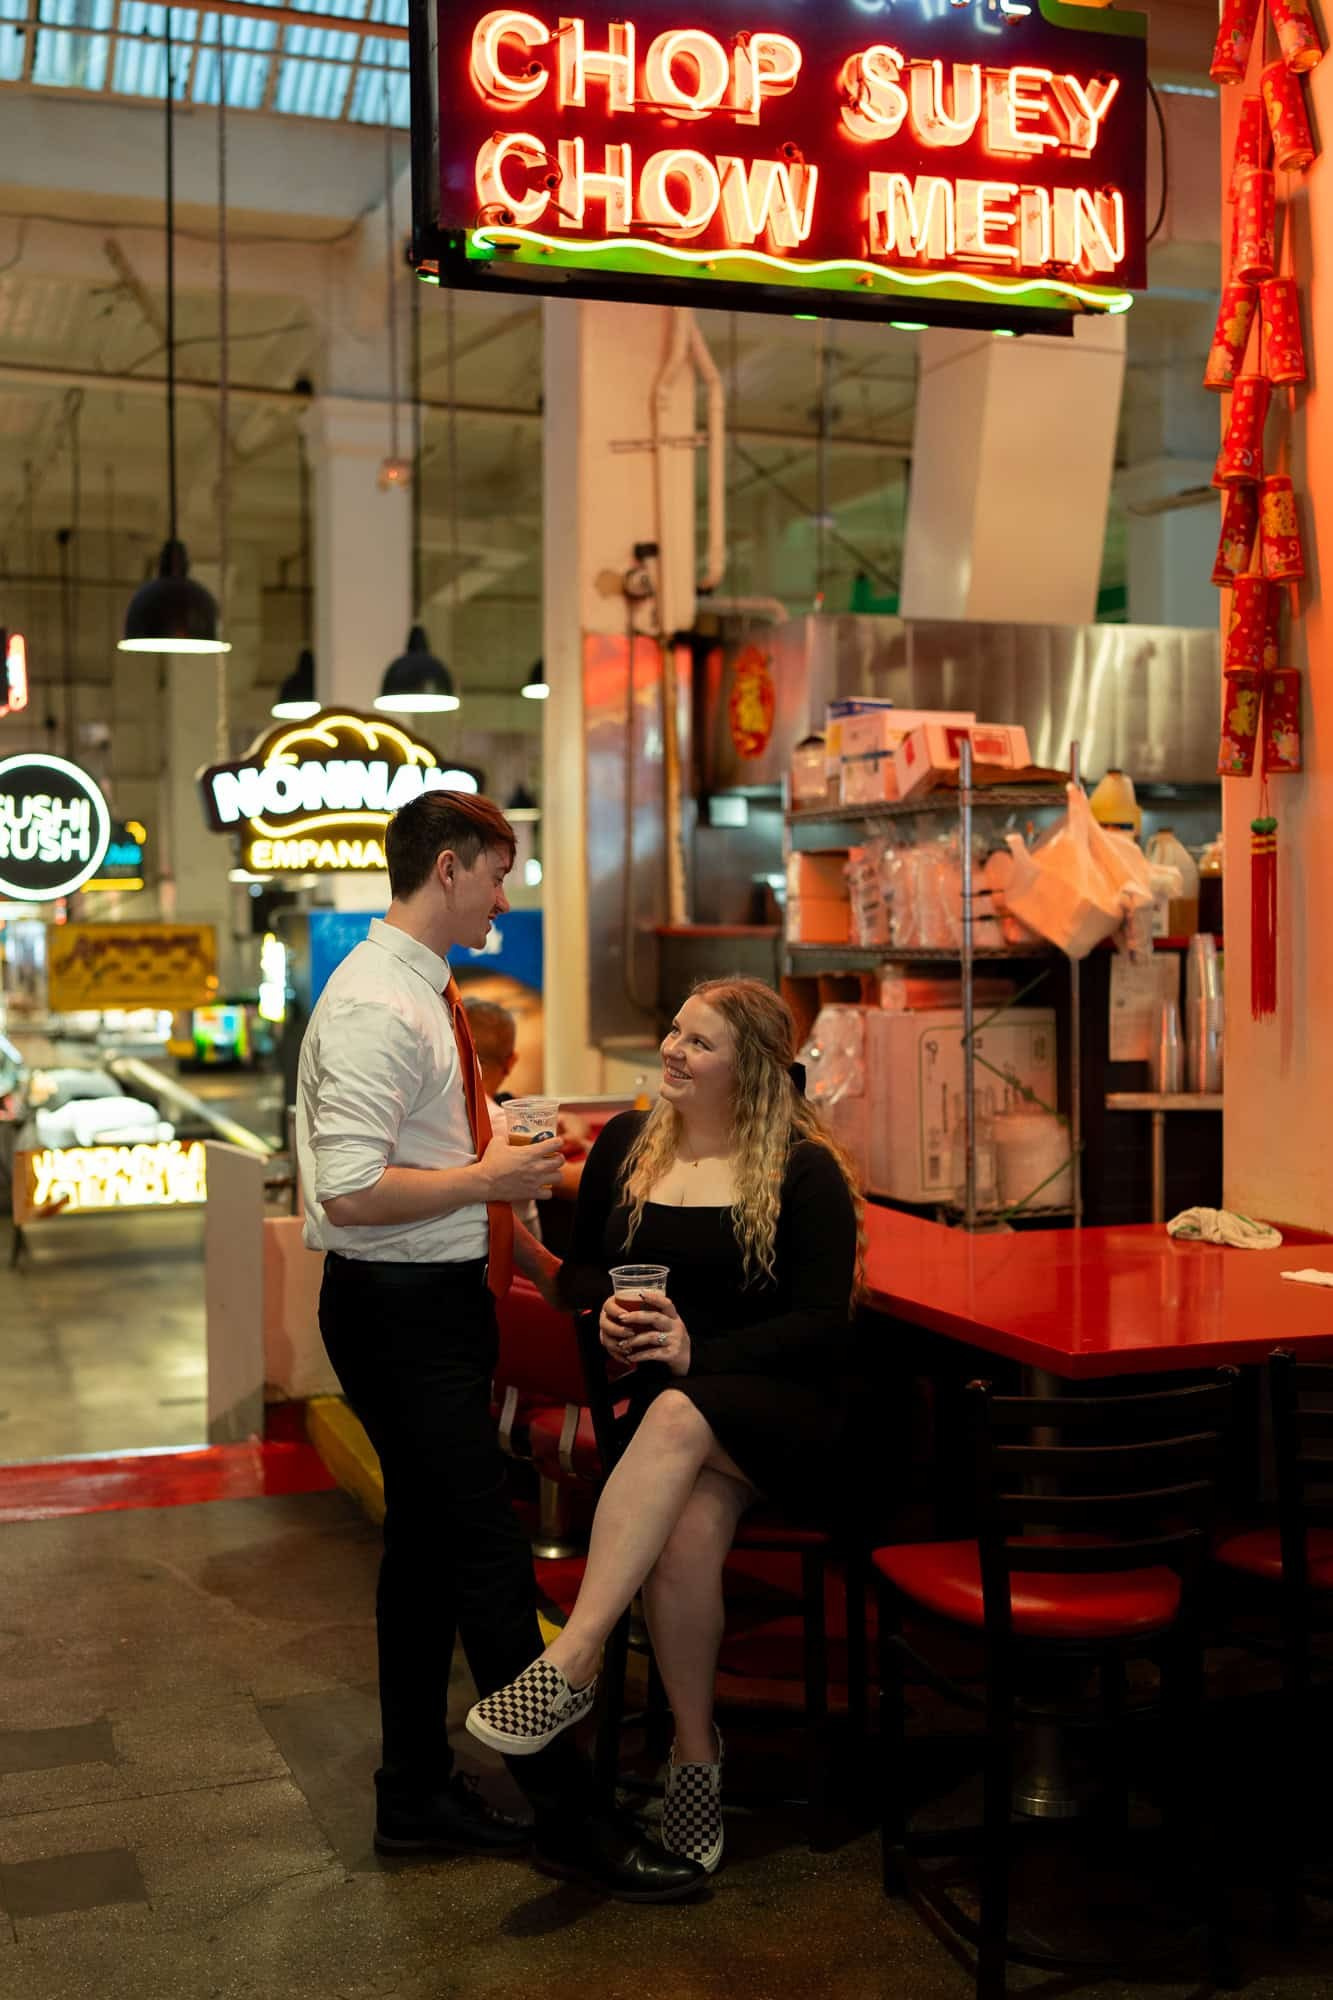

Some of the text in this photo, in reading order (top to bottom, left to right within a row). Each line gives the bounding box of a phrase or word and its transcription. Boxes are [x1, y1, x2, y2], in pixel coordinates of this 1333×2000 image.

[472, 9, 1118, 158] CHOP SUEY
[475, 132, 1125, 275] CHOW MEIN
[0, 794, 91, 831] USHI
[251, 839, 388, 869] EMPANA
